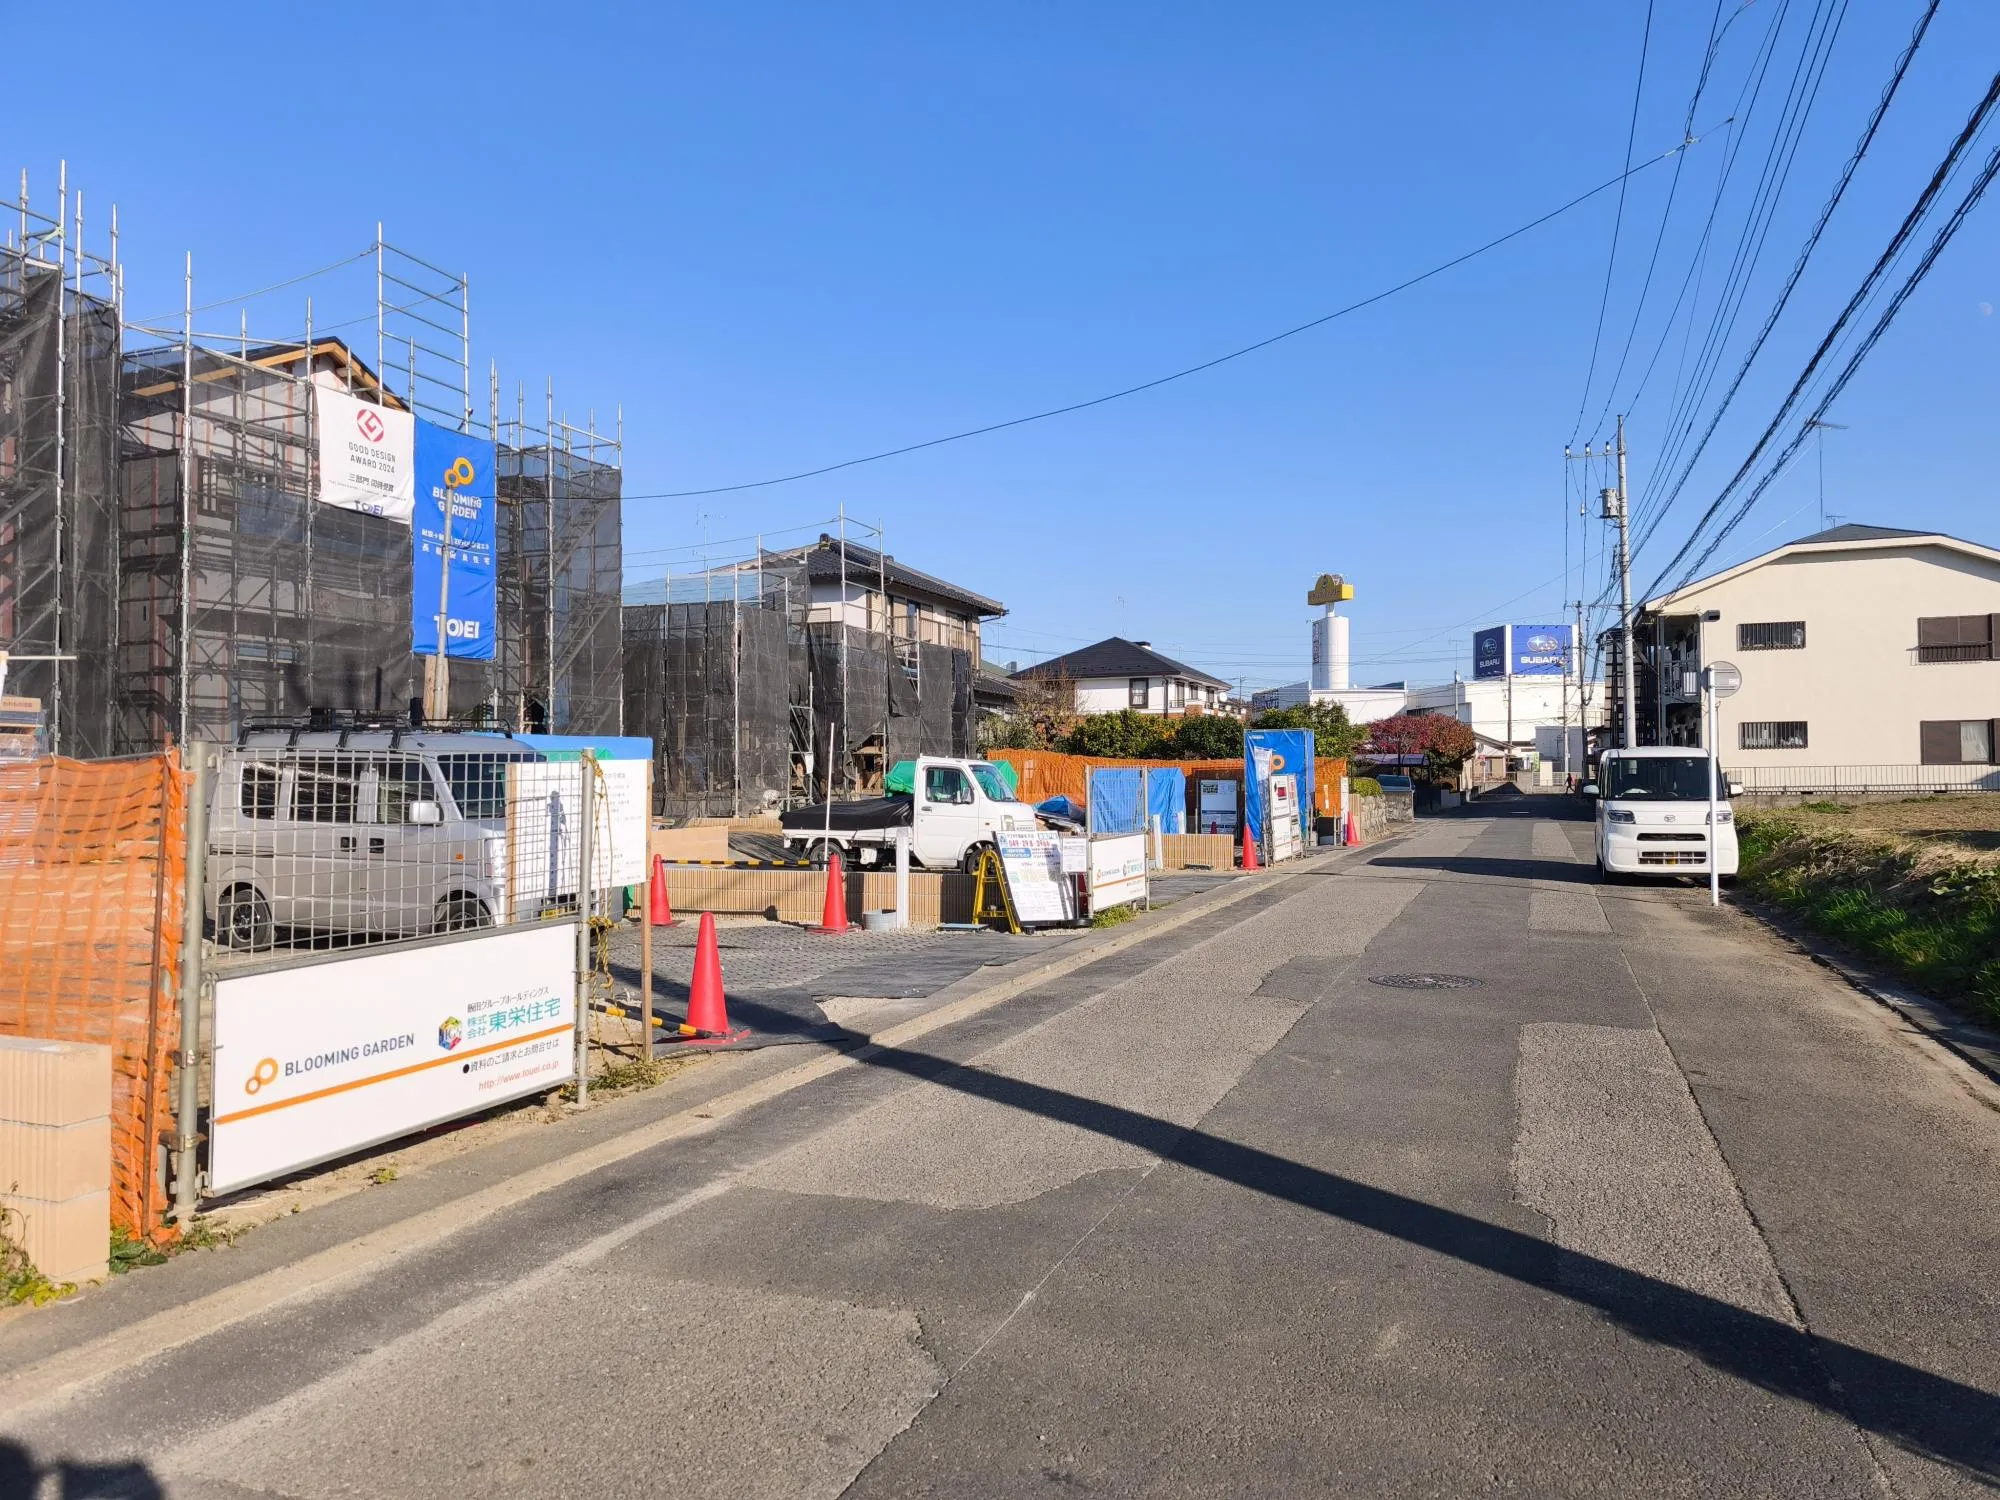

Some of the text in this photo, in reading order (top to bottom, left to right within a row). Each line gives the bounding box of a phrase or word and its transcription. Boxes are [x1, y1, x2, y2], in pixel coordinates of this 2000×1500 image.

[348, 441, 396, 463] GOOD DESIGN
[350, 454, 395, 473] AWARD 2024
[432, 486, 482, 508] BLOMING
[438, 501, 477, 519] GRDEN
[1480, 658, 1500, 668] SUBARU
[1520, 656, 1565, 664] SUBARU
[487, 998, 561, 1033] 東栄住宅
[284, 1046, 360, 1077] BLOOMING
[362, 1033, 415, 1058] GARDEN
